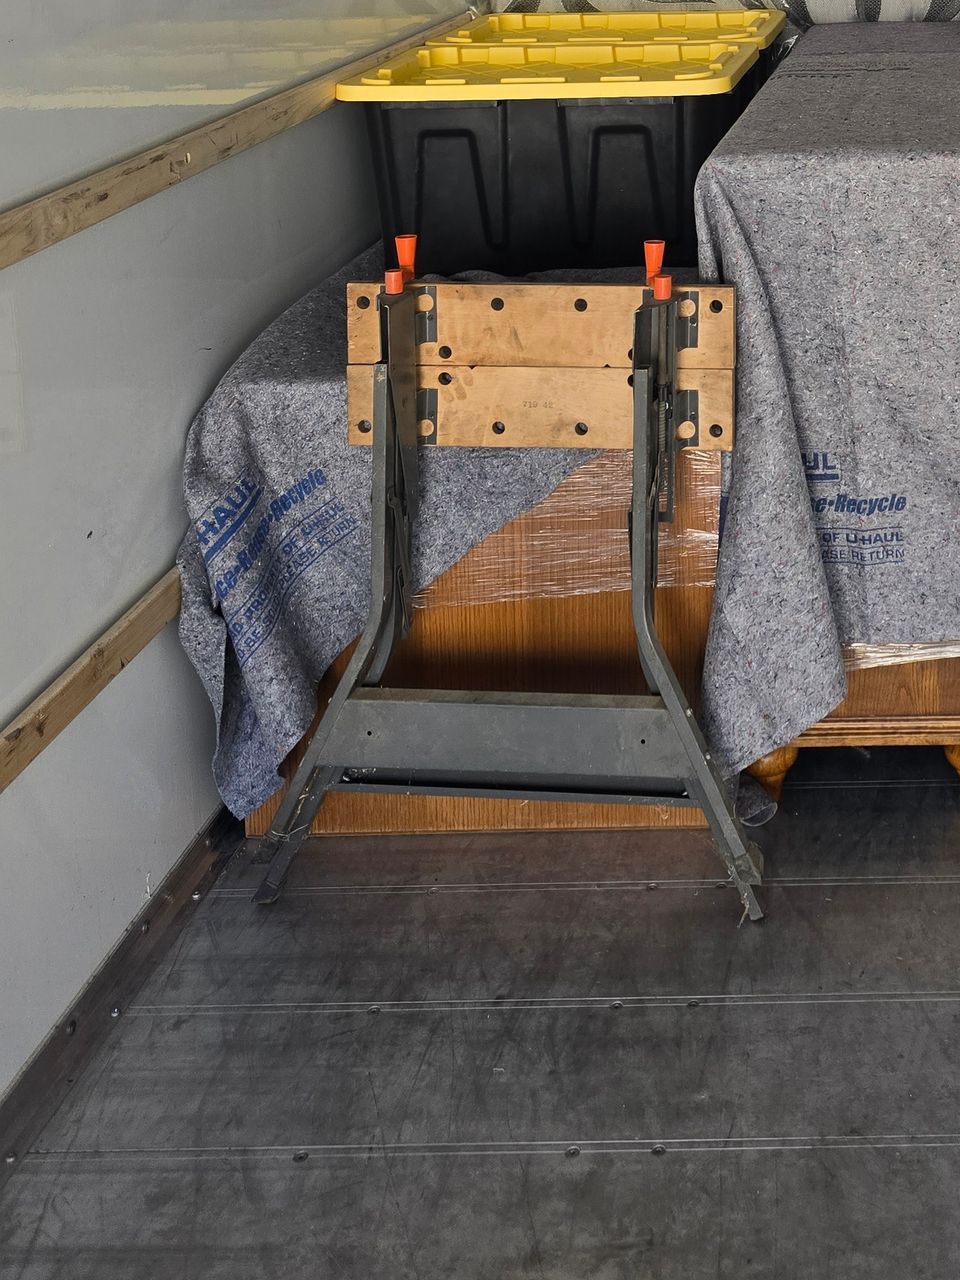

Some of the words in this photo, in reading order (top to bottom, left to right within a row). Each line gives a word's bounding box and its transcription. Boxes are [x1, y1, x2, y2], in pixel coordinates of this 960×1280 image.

[282, 536, 299, 555] OF
[300, 502, 345, 536] U-HAUL
[318, 516, 357, 546] RETURN
[822, 532, 840, 543] OF
[846, 531, 904, 546] U-HAUL
[851, 549, 905, 561] RETURN
